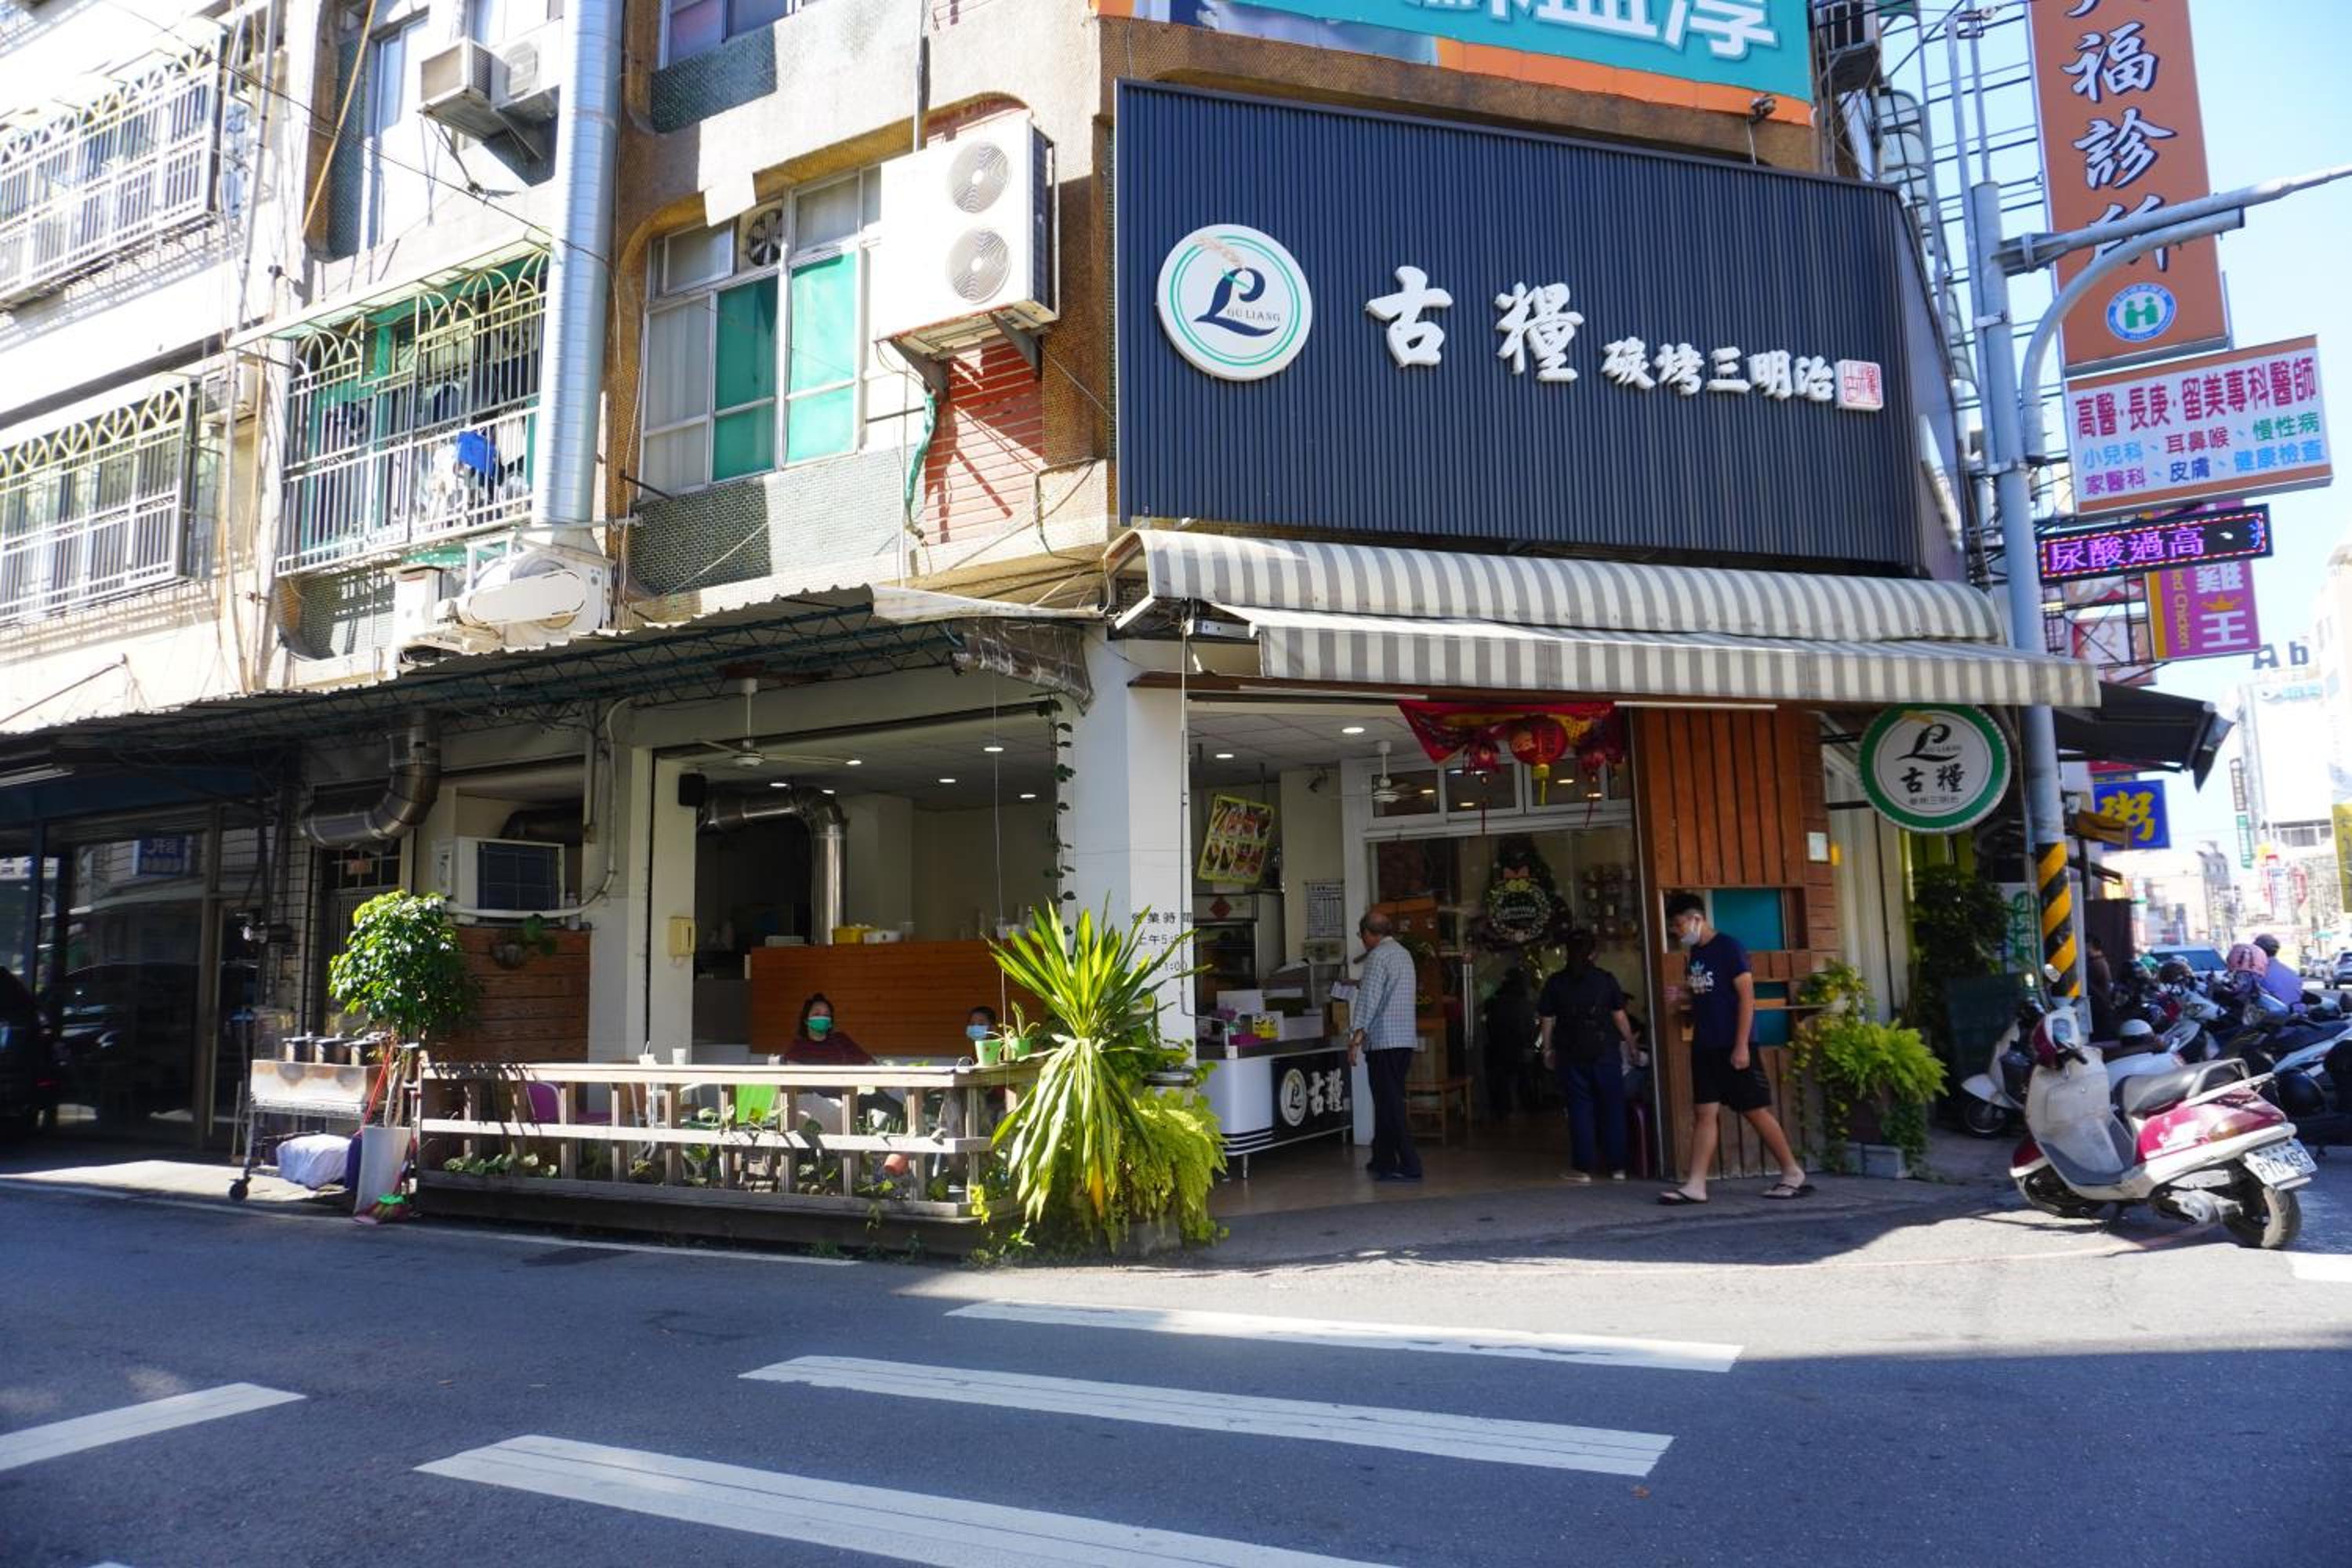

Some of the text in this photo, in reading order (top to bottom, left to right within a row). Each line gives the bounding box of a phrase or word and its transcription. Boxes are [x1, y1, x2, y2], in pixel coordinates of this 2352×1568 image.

[2063, 0, 2177, 270] 福診
[1365, 266, 1584, 382] 古糧
[1900, 763, 1965, 793] 古糧
